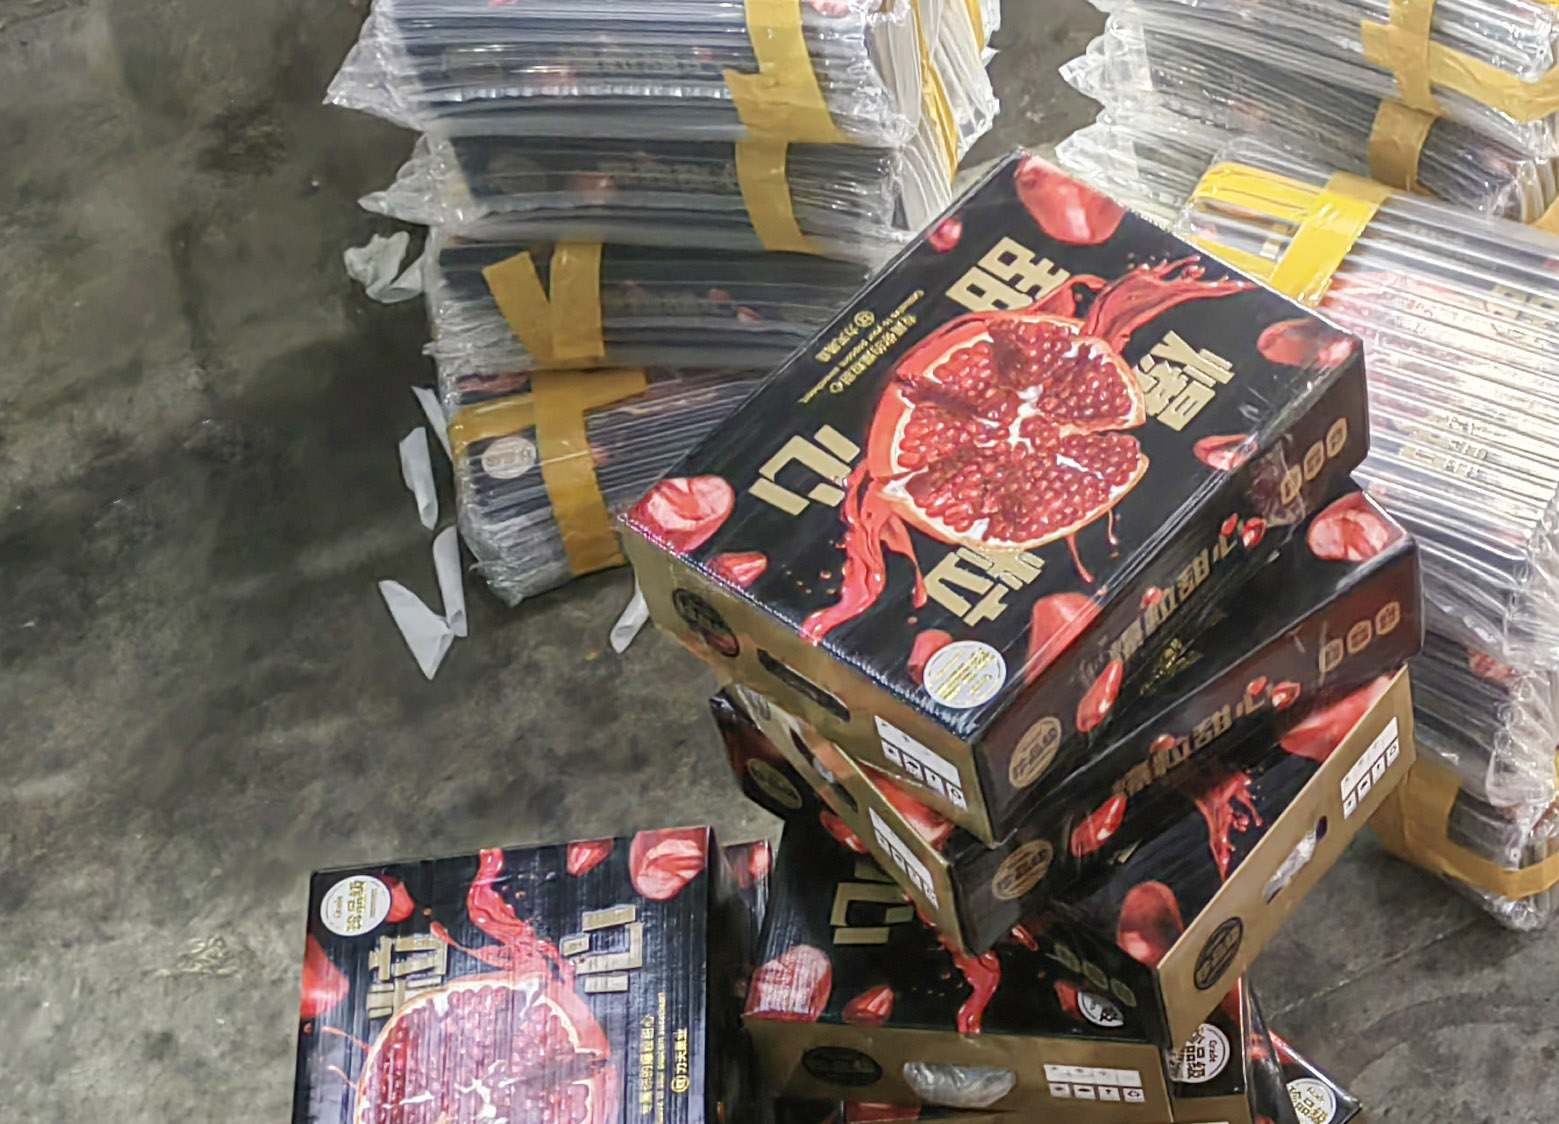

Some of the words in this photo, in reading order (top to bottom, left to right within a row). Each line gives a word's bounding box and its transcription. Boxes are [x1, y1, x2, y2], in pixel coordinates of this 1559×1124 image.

[945, 236, 1070, 314] 甜
[748, 424, 861, 516] 心
[560, 904, 644, 994] 心
